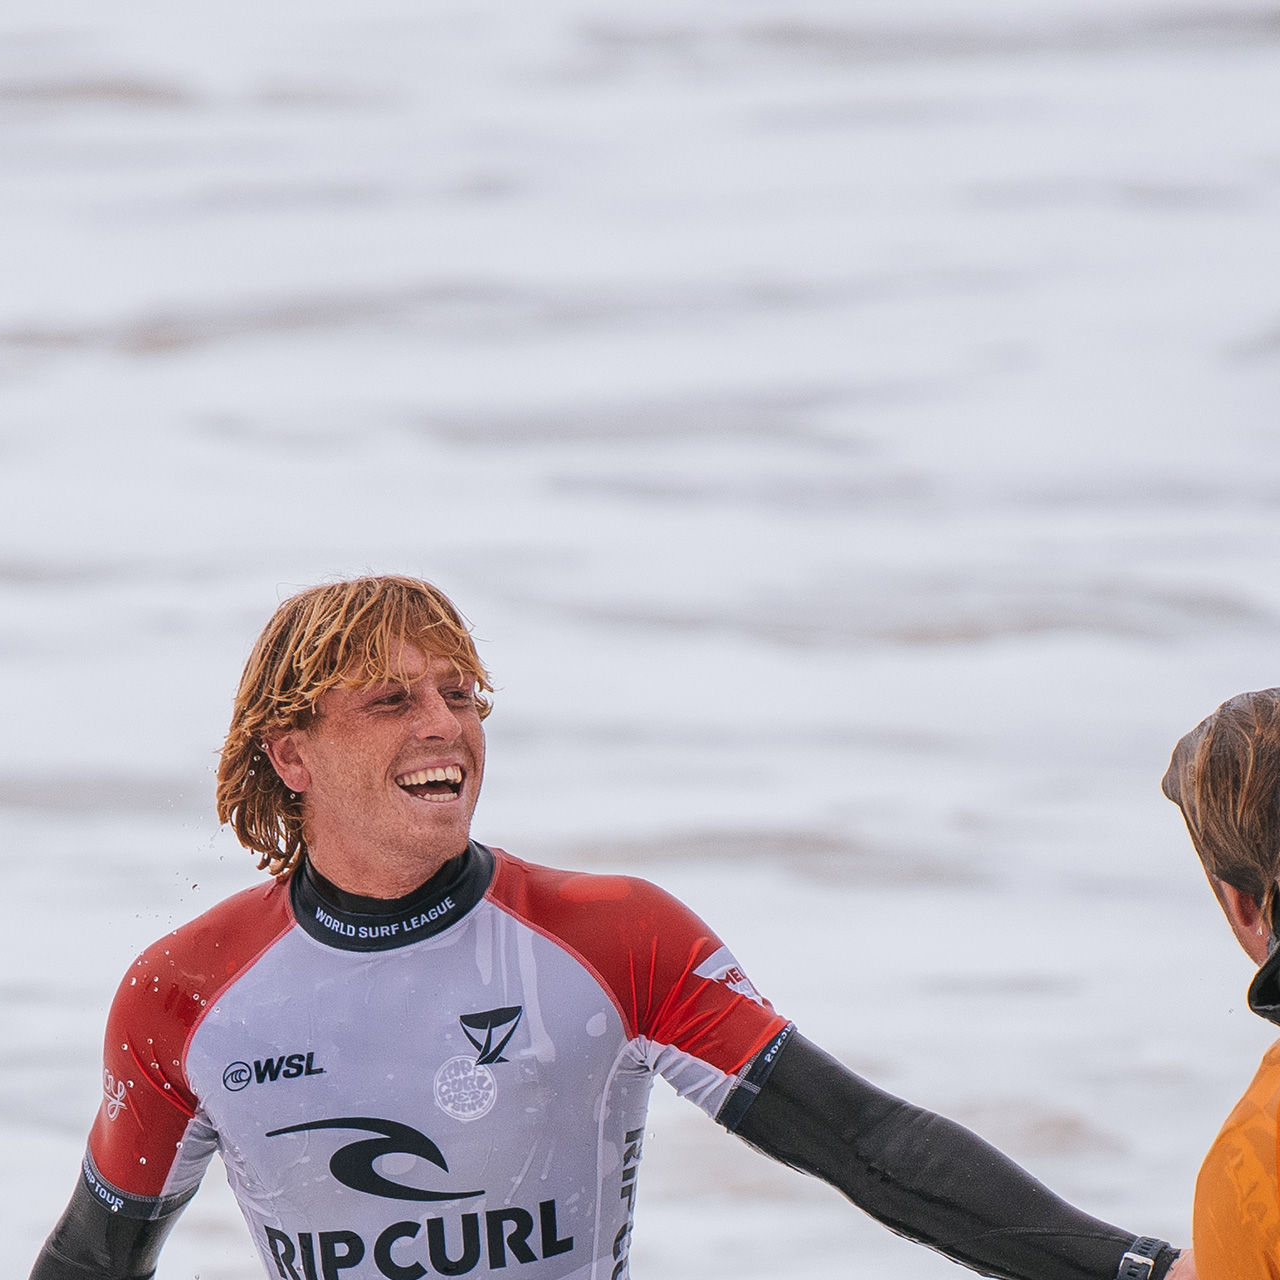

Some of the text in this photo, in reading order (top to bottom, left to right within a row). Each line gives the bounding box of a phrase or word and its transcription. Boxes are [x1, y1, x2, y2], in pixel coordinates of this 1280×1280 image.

[315, 895, 457, 939] WORLD SURF LEAGUE
[253, 1051, 325, 1084] WSL
[93, 1183, 125, 1210] TOUR
